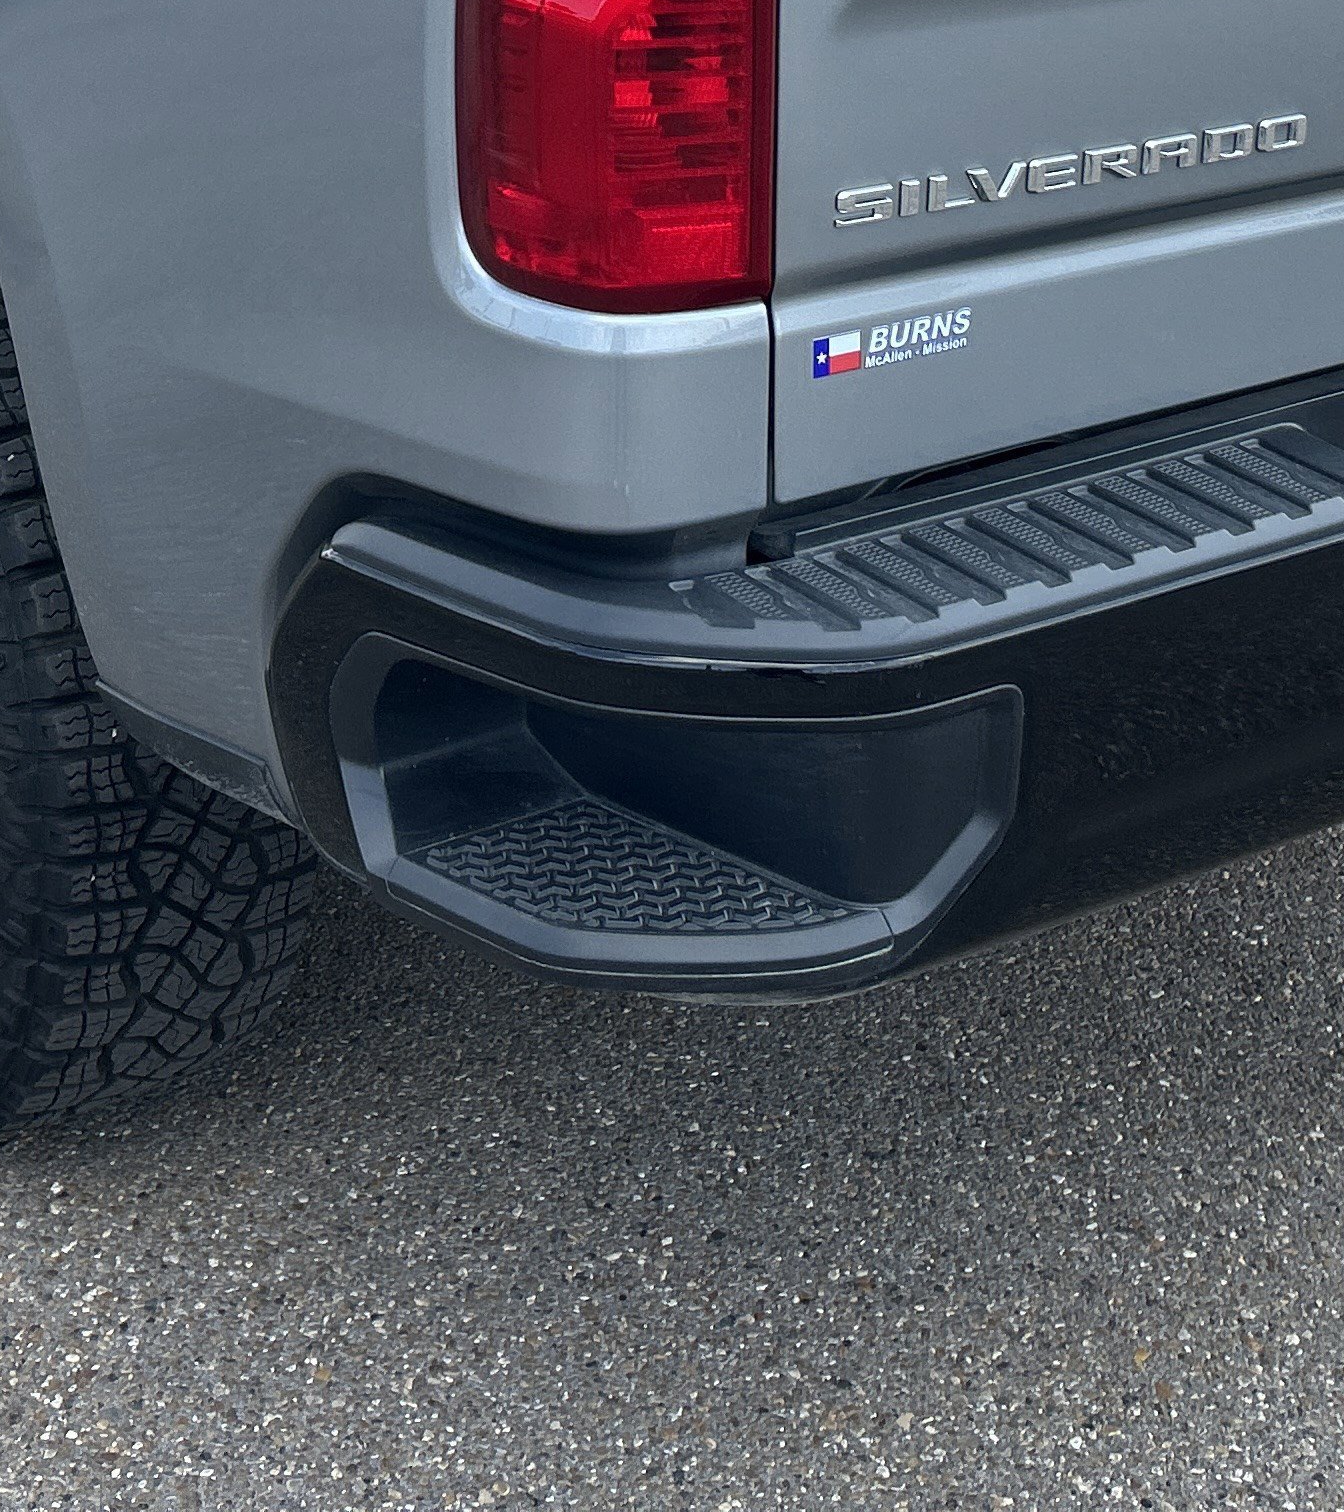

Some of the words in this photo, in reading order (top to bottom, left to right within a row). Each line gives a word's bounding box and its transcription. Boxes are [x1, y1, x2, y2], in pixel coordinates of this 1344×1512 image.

[834, 113, 1307, 228] SILVERADO
[865, 349, 912, 368] McAllen
[922, 337, 967, 355] Mission
[869, 307, 972, 353] BURNS
